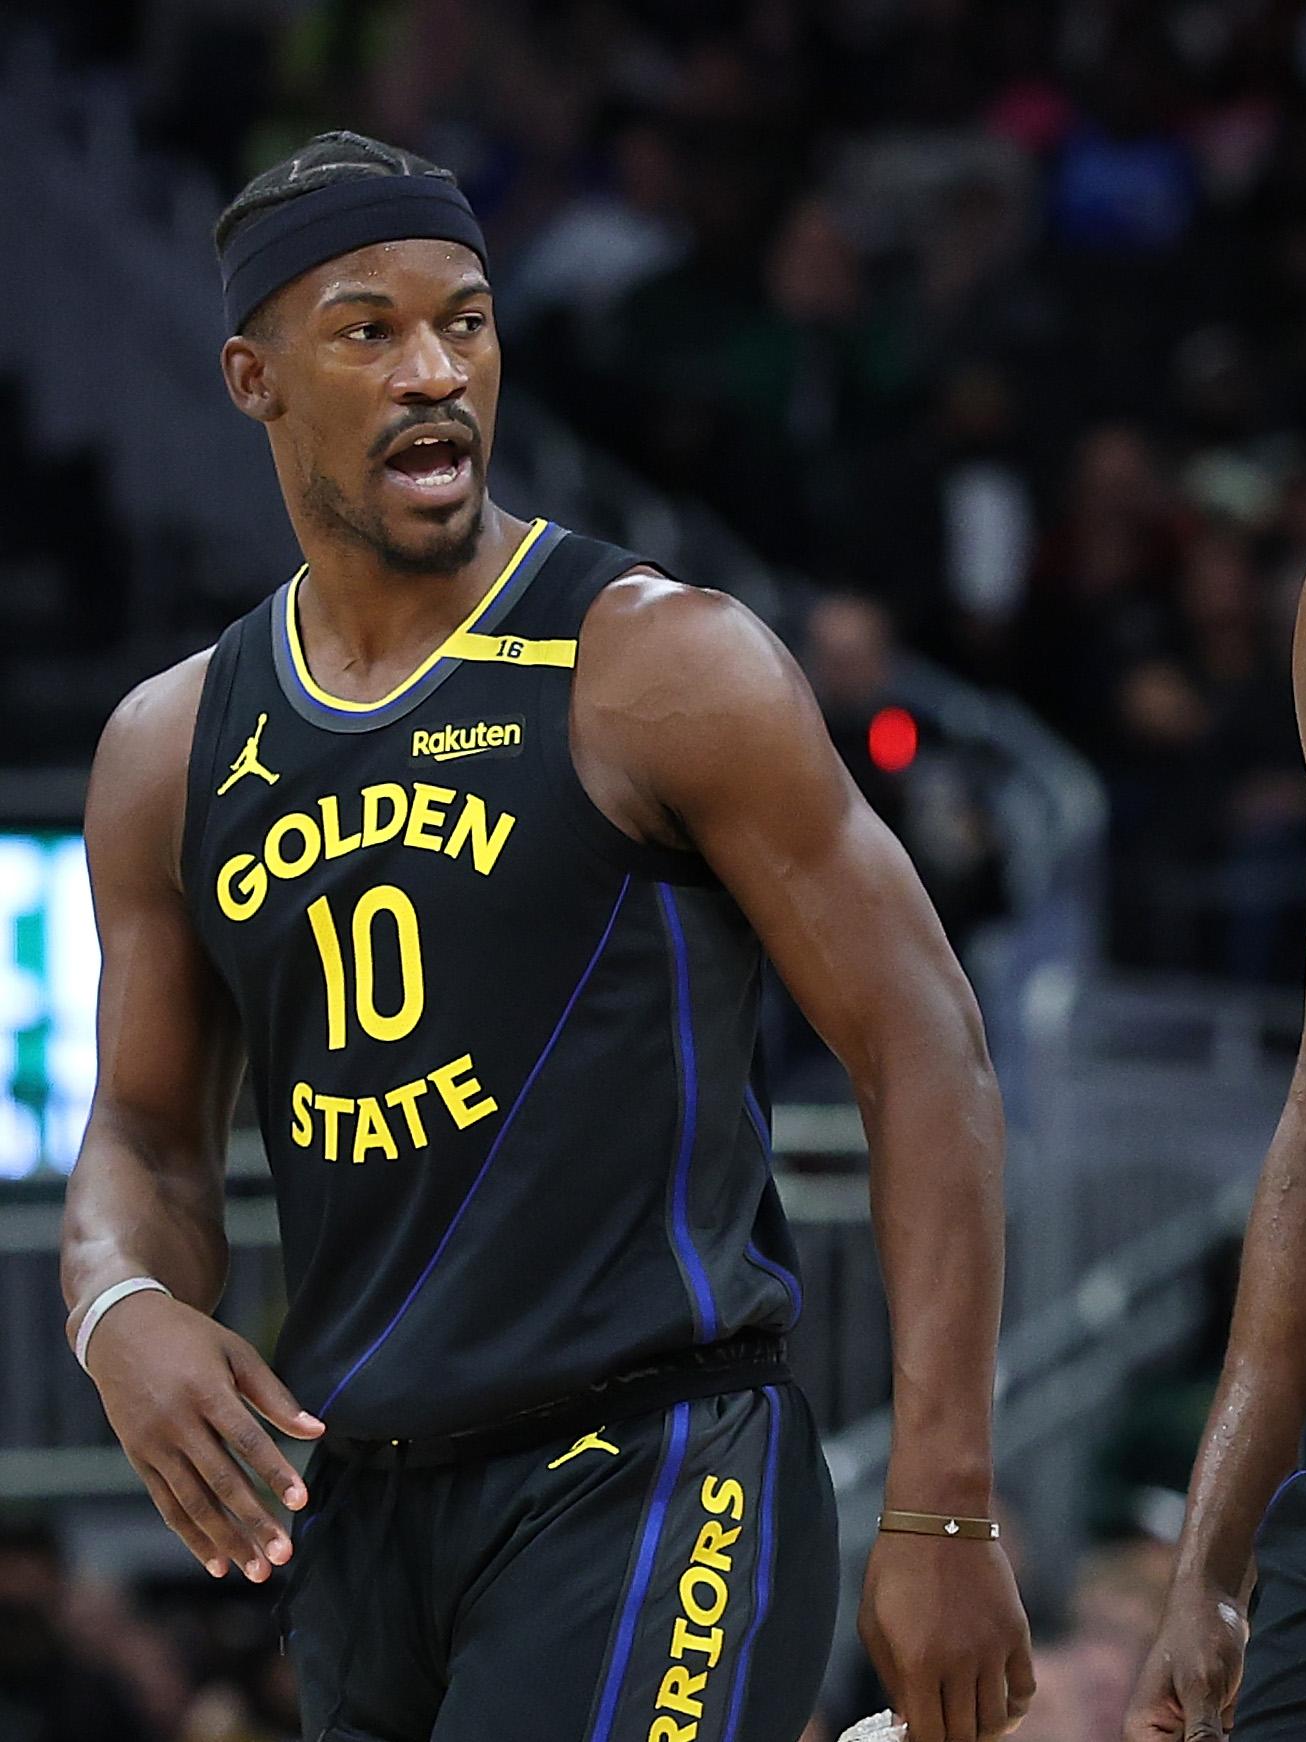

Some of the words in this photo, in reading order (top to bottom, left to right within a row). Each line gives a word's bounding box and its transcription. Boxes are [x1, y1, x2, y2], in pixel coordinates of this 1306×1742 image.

[496, 639, 524, 659] 16
[411, 721, 521, 758] Rakuten
[216, 782, 516, 922] GOLDEN
[307, 884, 426, 1051] 10
[291, 1054, 499, 1164] STATE
